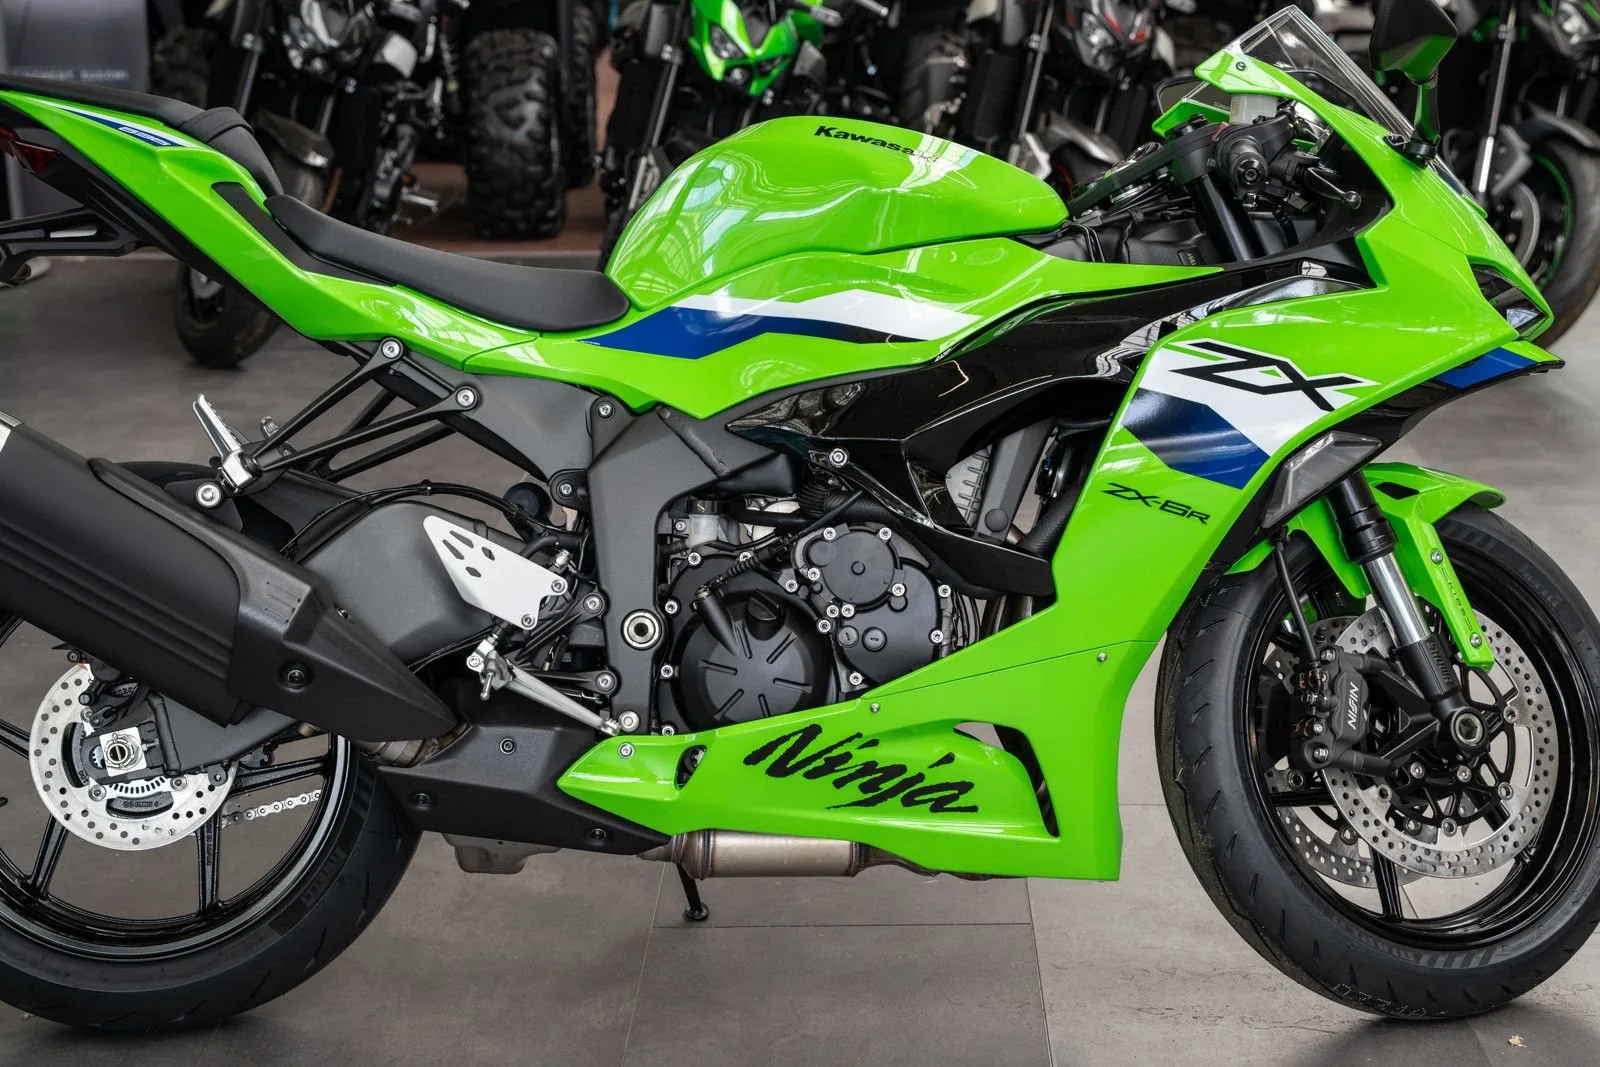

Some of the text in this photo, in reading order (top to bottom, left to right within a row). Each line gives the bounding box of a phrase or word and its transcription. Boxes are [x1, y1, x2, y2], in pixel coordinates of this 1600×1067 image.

[1168, 341, 1364, 413] ZX
[1100, 482, 1211, 525] ZX-6R
[1347, 681, 1359, 730] NISSIN
[743, 723, 979, 813] Ninja
